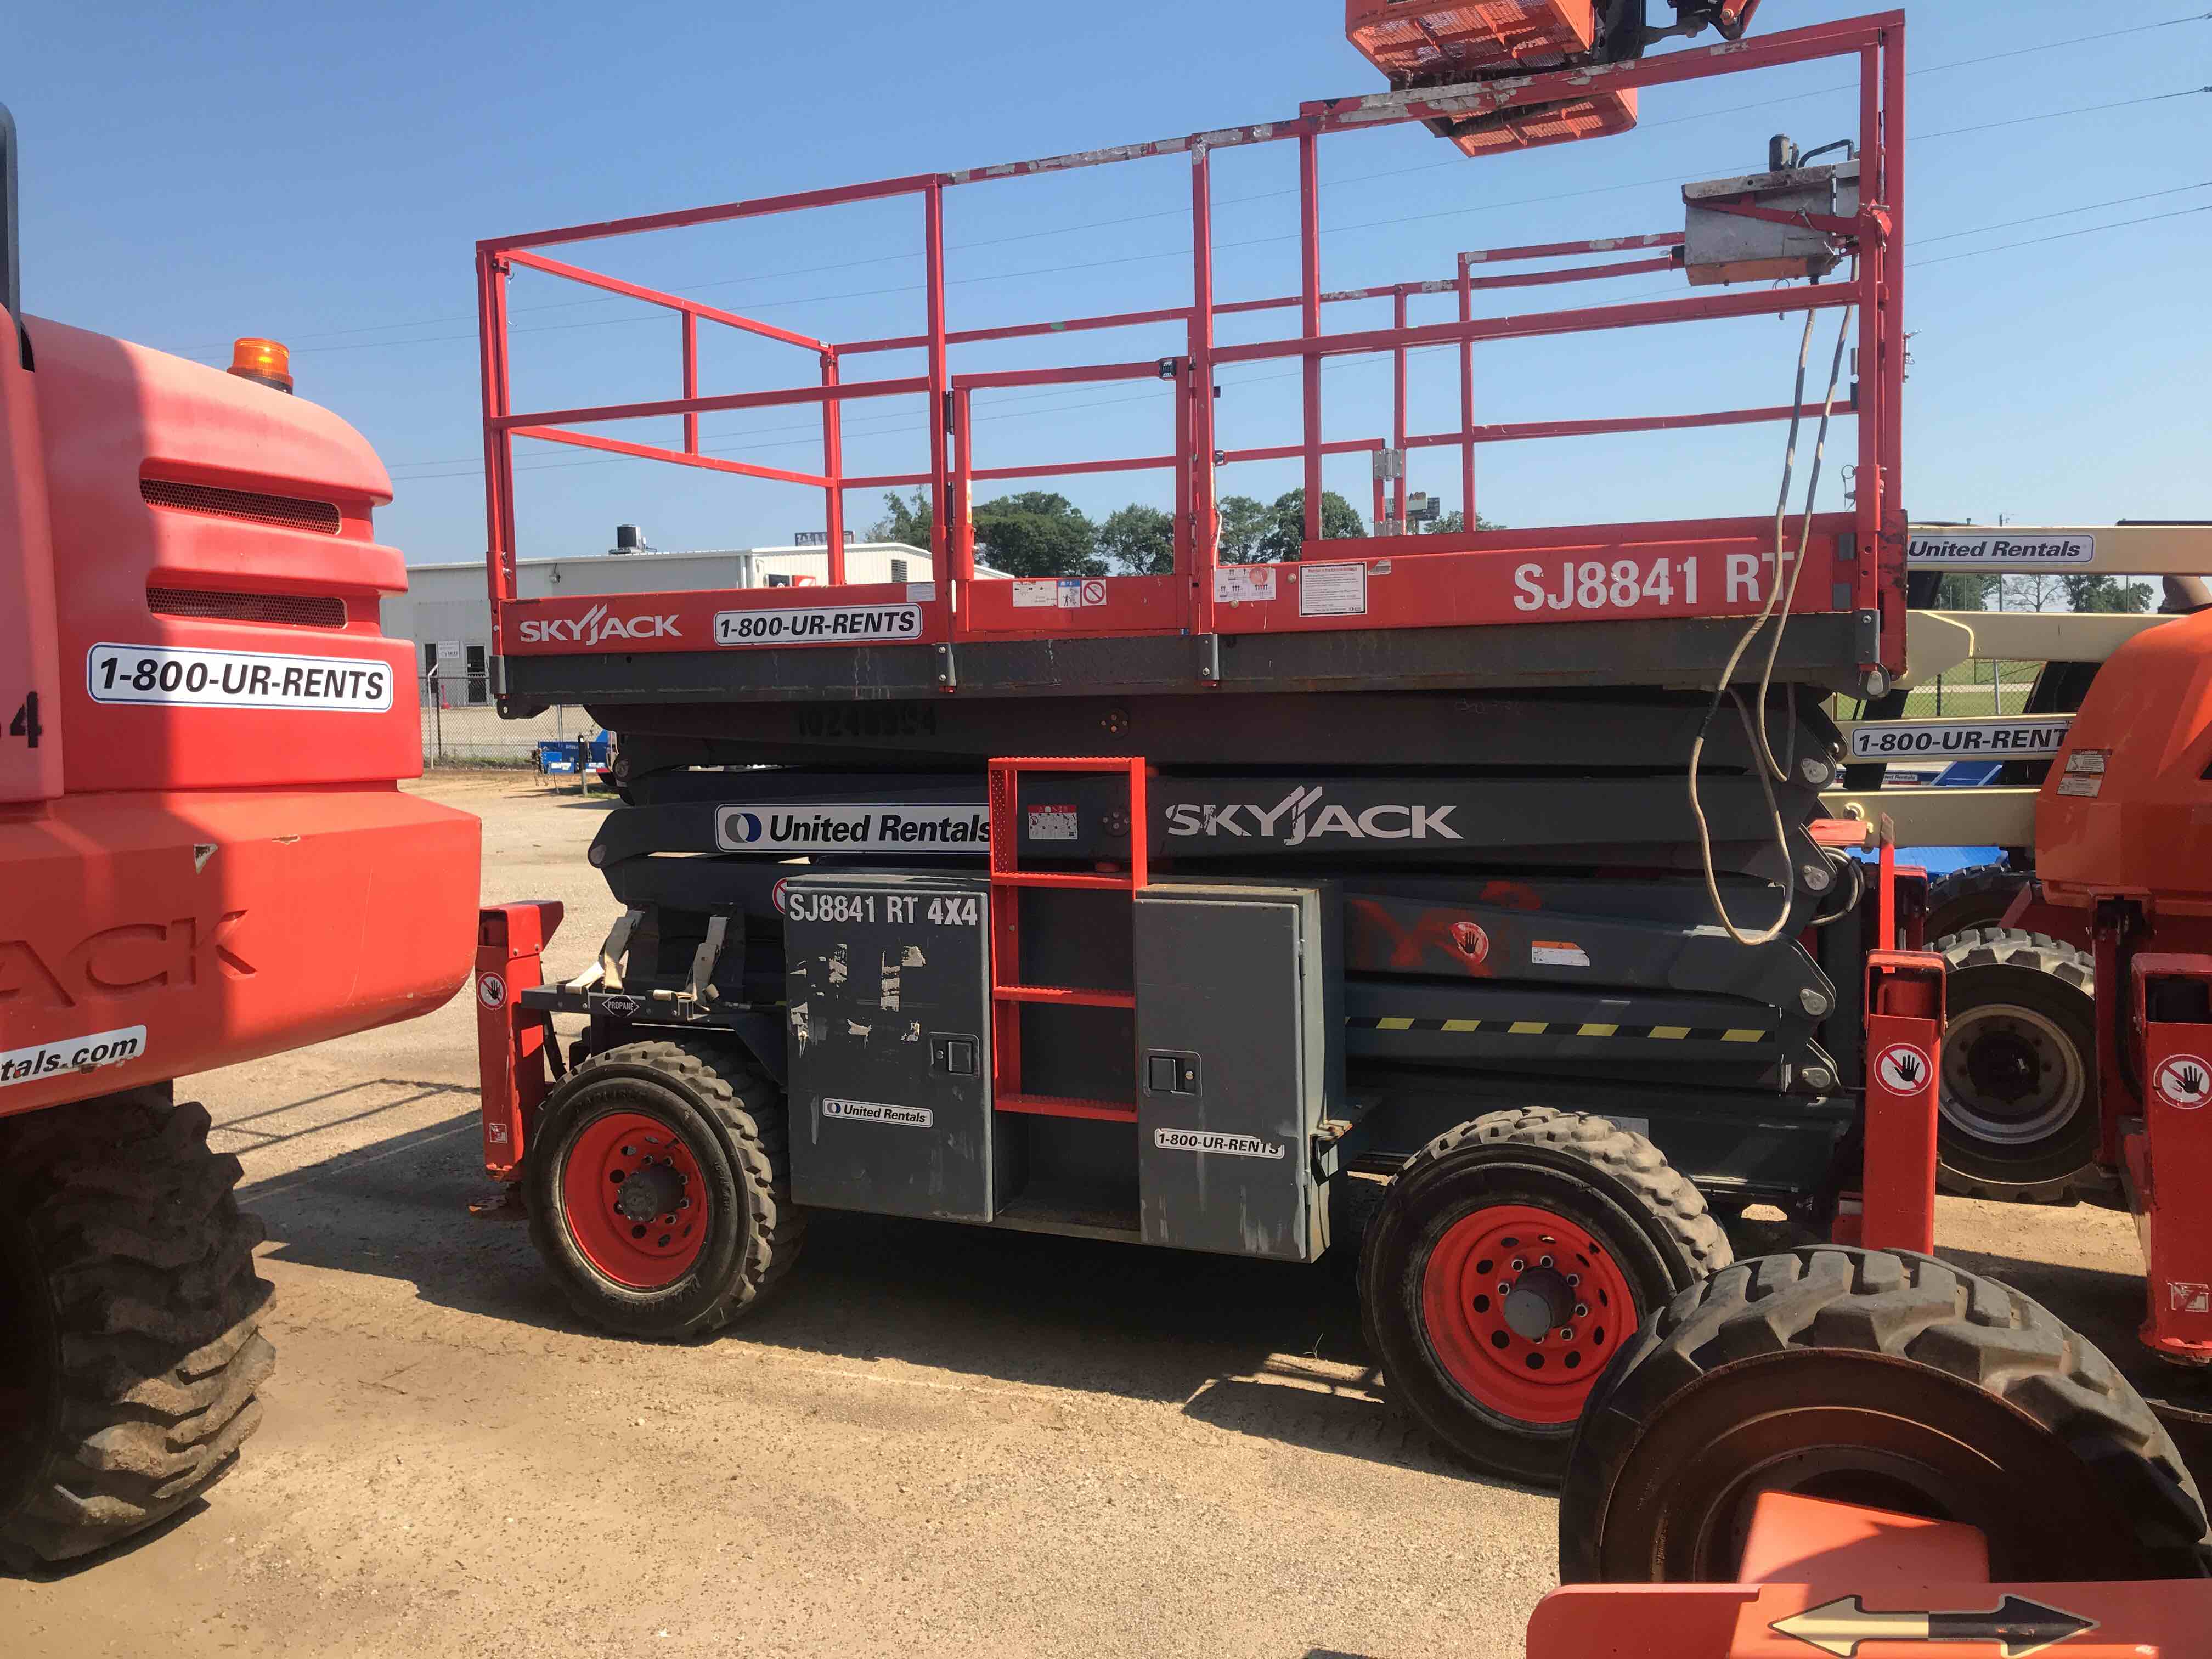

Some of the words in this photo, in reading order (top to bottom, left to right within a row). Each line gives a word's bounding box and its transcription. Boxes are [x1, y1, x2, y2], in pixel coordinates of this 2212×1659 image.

[1909, 541, 1987, 557] United
[1991, 541, 2081, 557] Rentals
[1514, 556, 1697, 611] SJ8841
[1726, 552, 1795, 603] RT
[520, 604, 682, 646] SKYJACK
[720, 611, 915, 639] 1-800-UR-RENTS
[100, 657, 384, 700] 1-800-UR-RENTS
[0, 691, 42, 748] 4
[1859, 728, 2069, 752] 1-800-UR-RENT
[770, 815, 871, 842] United
[879, 814, 990, 843] Rentals
[1165, 785, 1464, 845] SKYJACK
[789, 894, 875, 922] SJ8841
[887, 896, 918, 923] RT
[928, 898, 978, 926] 4X4
[607, 1001, 634, 1011] PROPANE
[844, 1104, 881, 1118] United
[884, 1108, 926, 1122] Rentals
